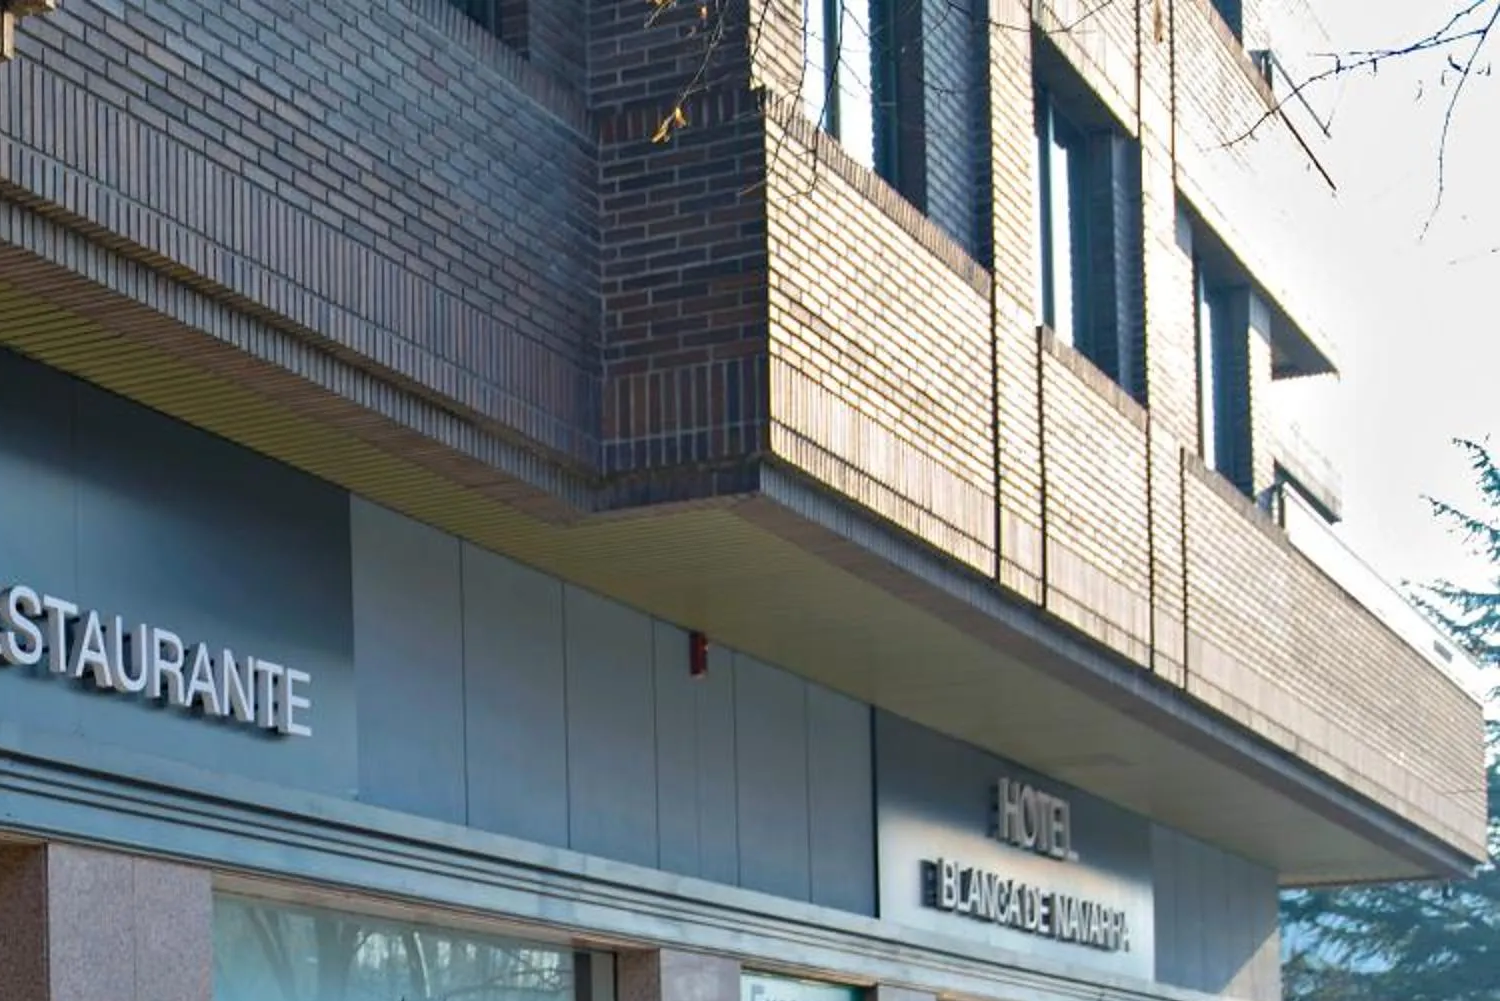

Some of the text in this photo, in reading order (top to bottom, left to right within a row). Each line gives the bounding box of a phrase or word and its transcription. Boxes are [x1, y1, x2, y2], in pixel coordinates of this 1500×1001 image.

[998, 776, 1080, 862] HOTEL
[937, 857, 1024, 927] BLANCA
[1023, 885, 1051, 934] DE
